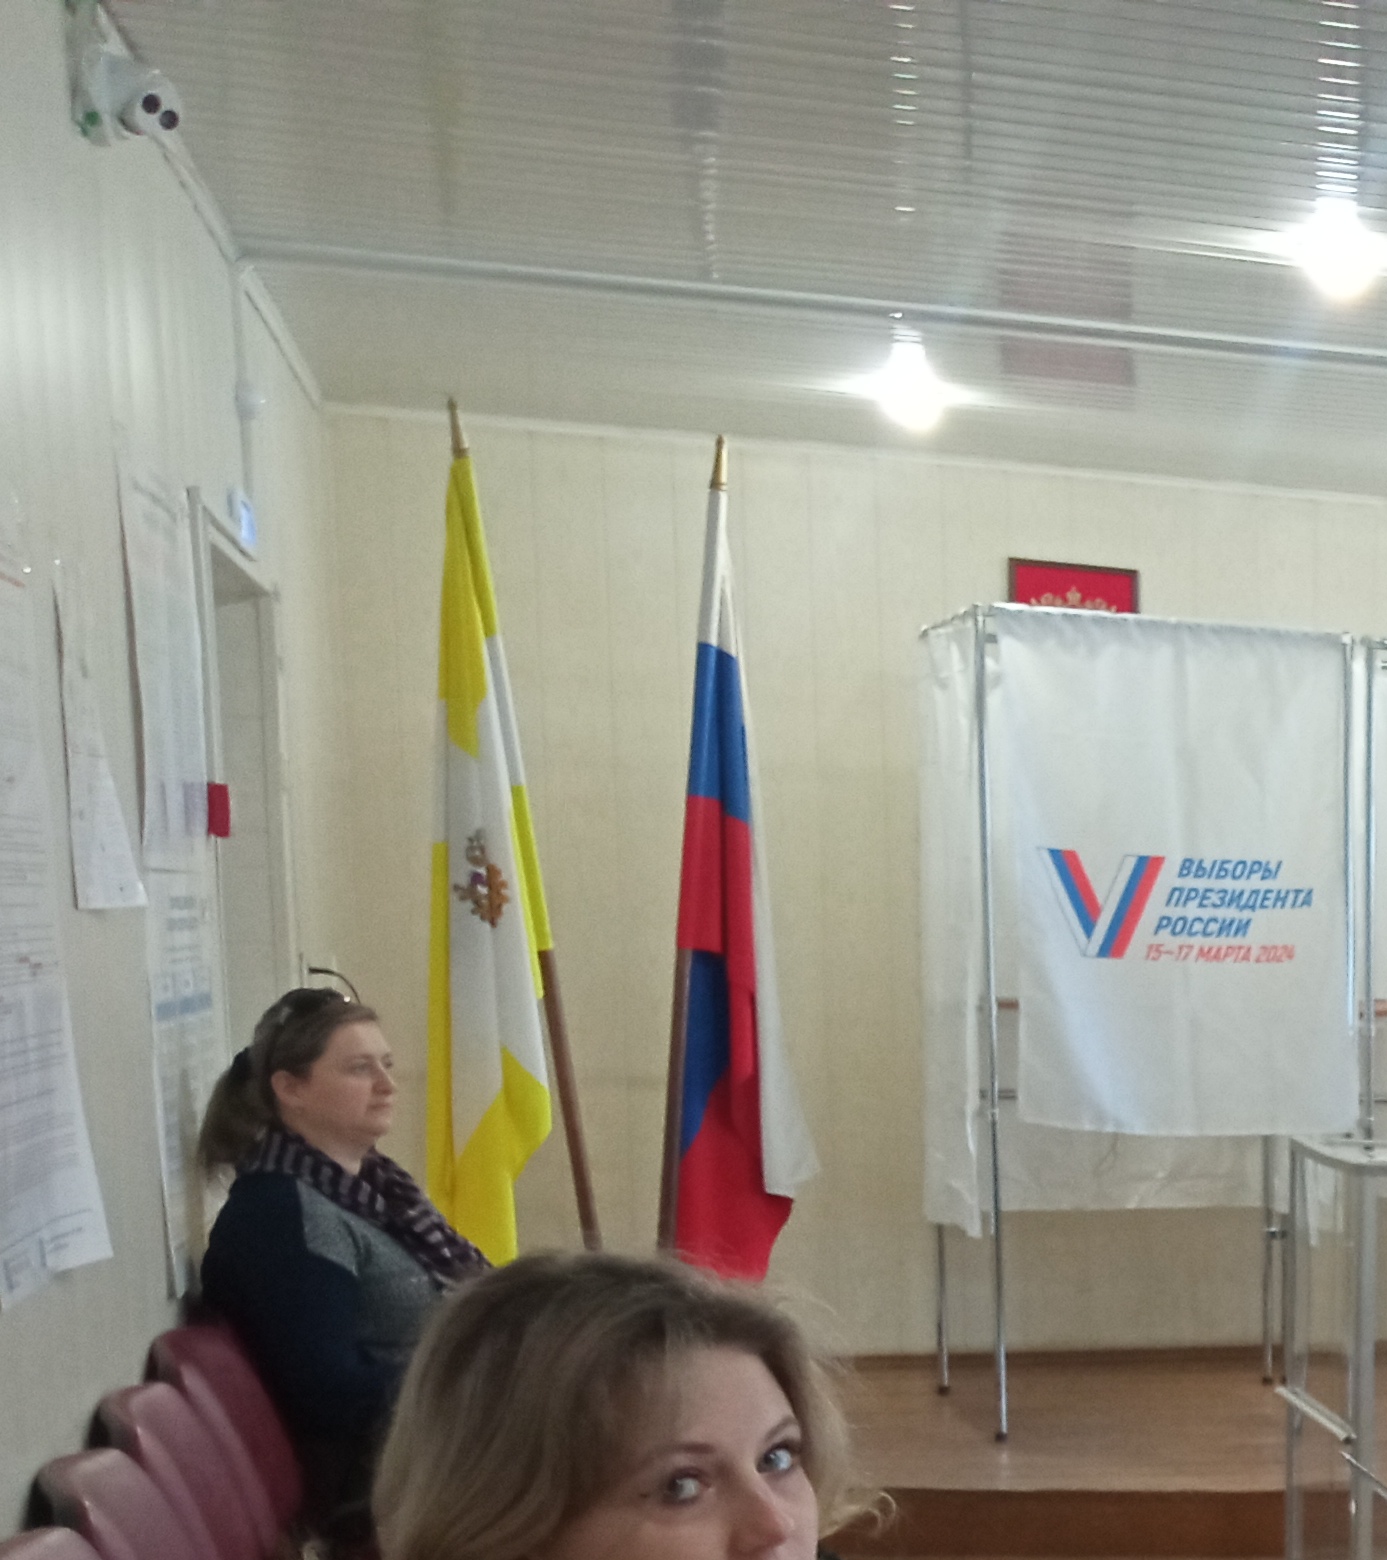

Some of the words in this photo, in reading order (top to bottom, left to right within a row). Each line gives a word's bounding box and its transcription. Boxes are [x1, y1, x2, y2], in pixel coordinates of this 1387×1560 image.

[1177, 858, 1283, 881] ВЫБОРЫ
[1165, 887, 1314, 912] ПРЕЗИДЕНТА
[1153, 916, 1252, 938] РОССИИ
[1195, 944, 1252, 963] МАРТА
[1255, 944, 1295, 964] 2024
